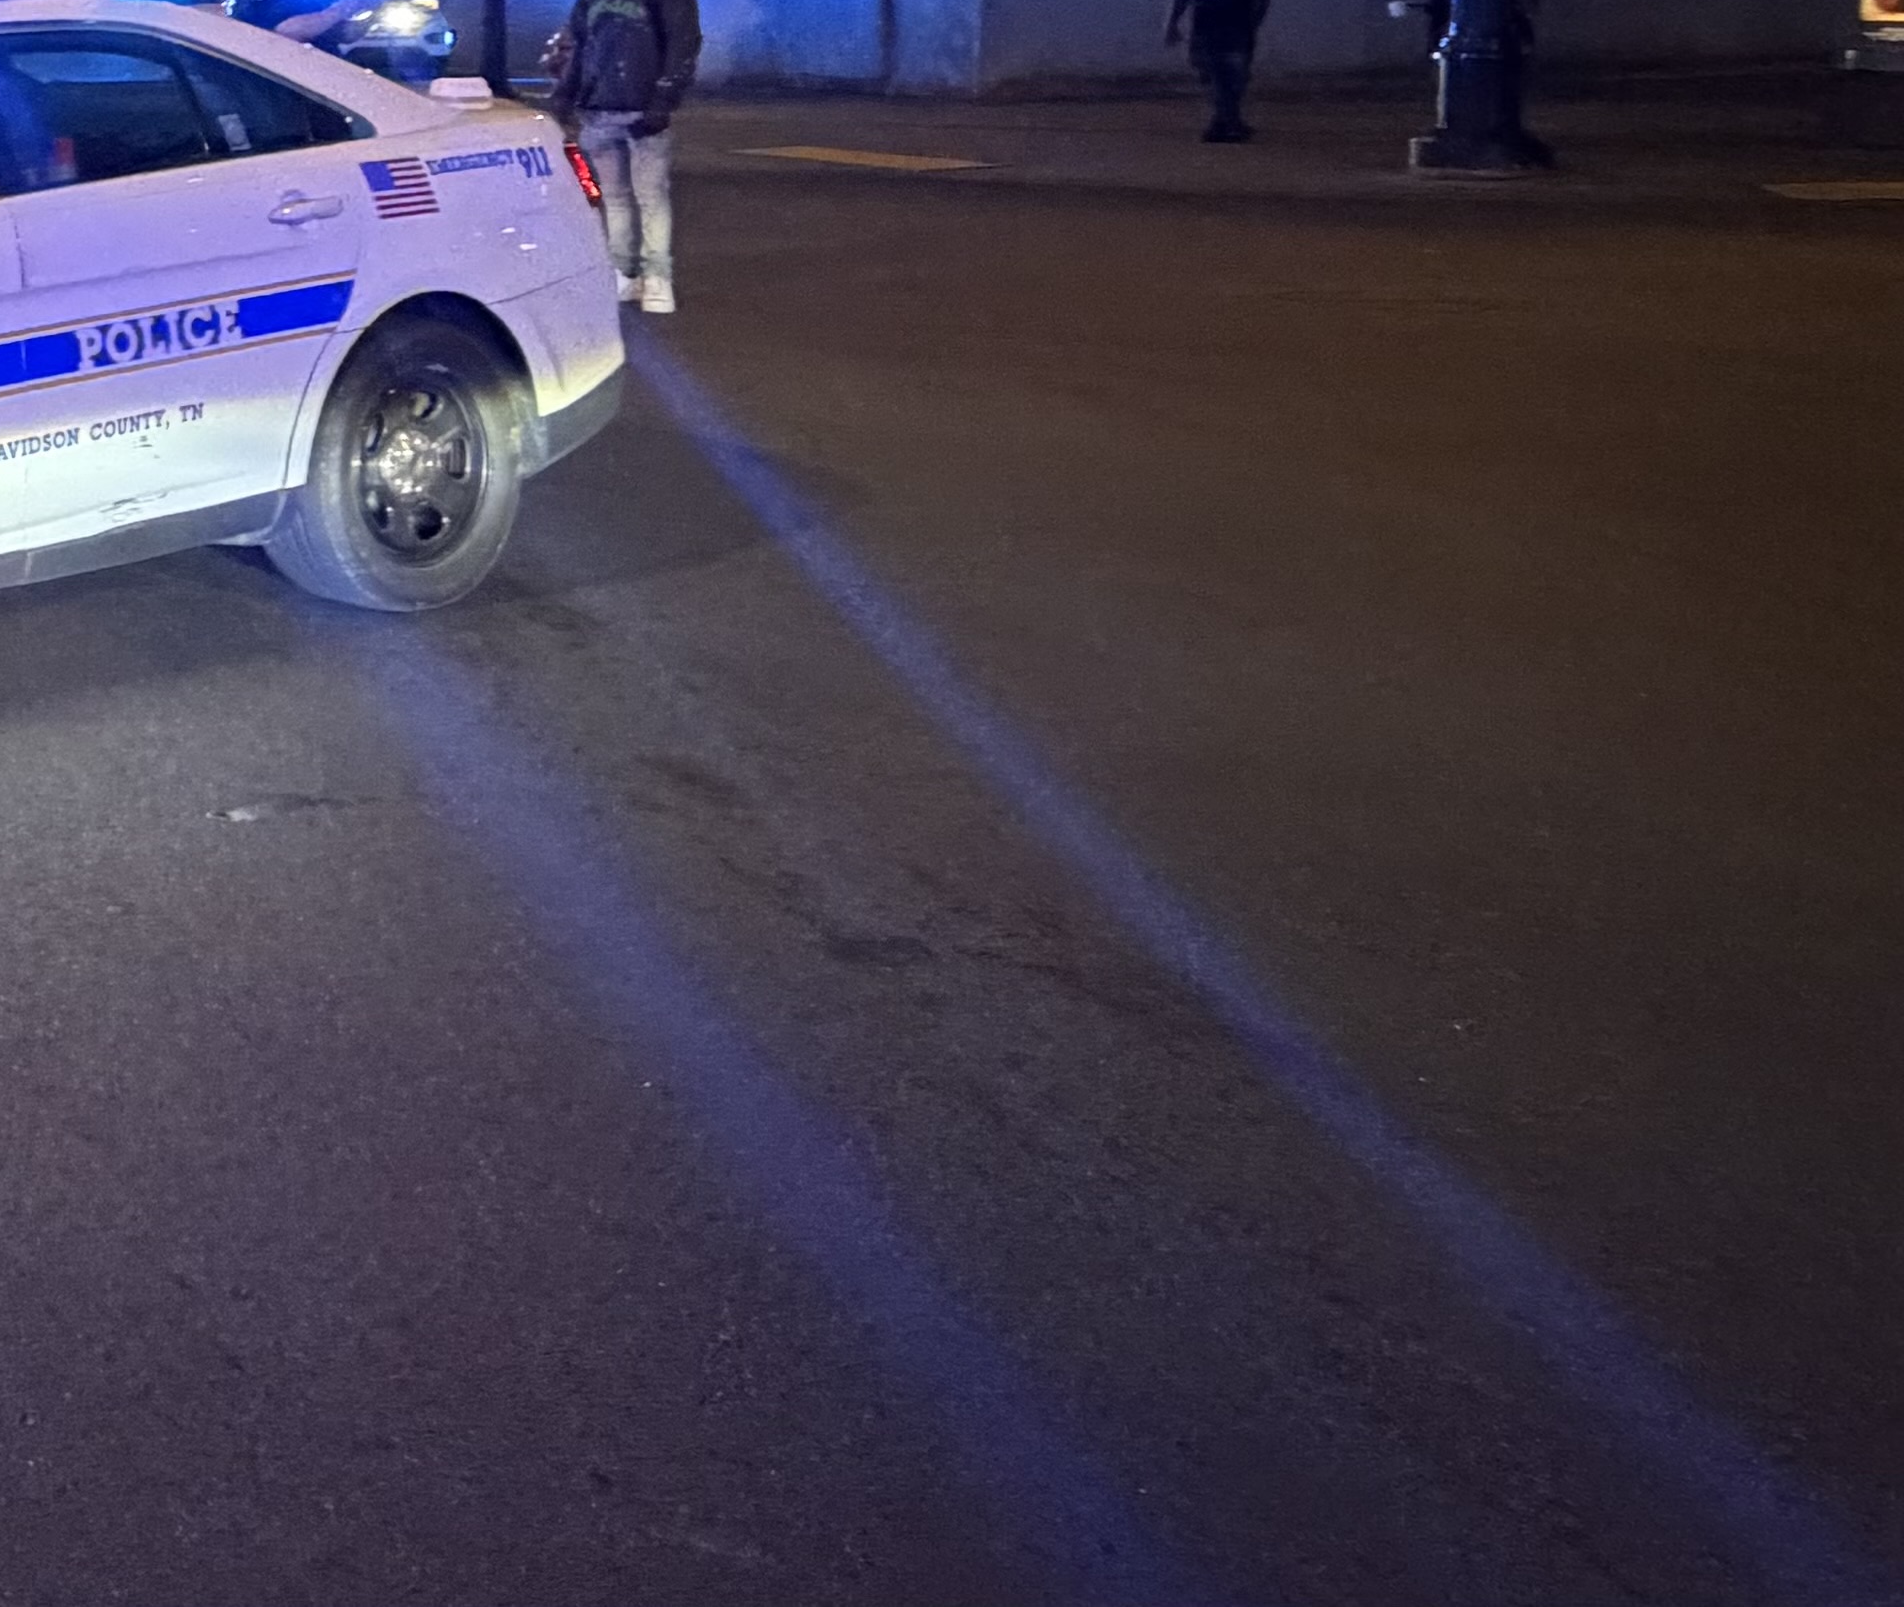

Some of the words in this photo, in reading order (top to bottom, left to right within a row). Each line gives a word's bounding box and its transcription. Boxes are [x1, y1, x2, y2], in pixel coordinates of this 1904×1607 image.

[515, 145, 554, 179] 911
[76, 301, 242, 371] POLICE
[89, 408, 172, 442] COUNTY,
[179, 402, 205, 424] TN
